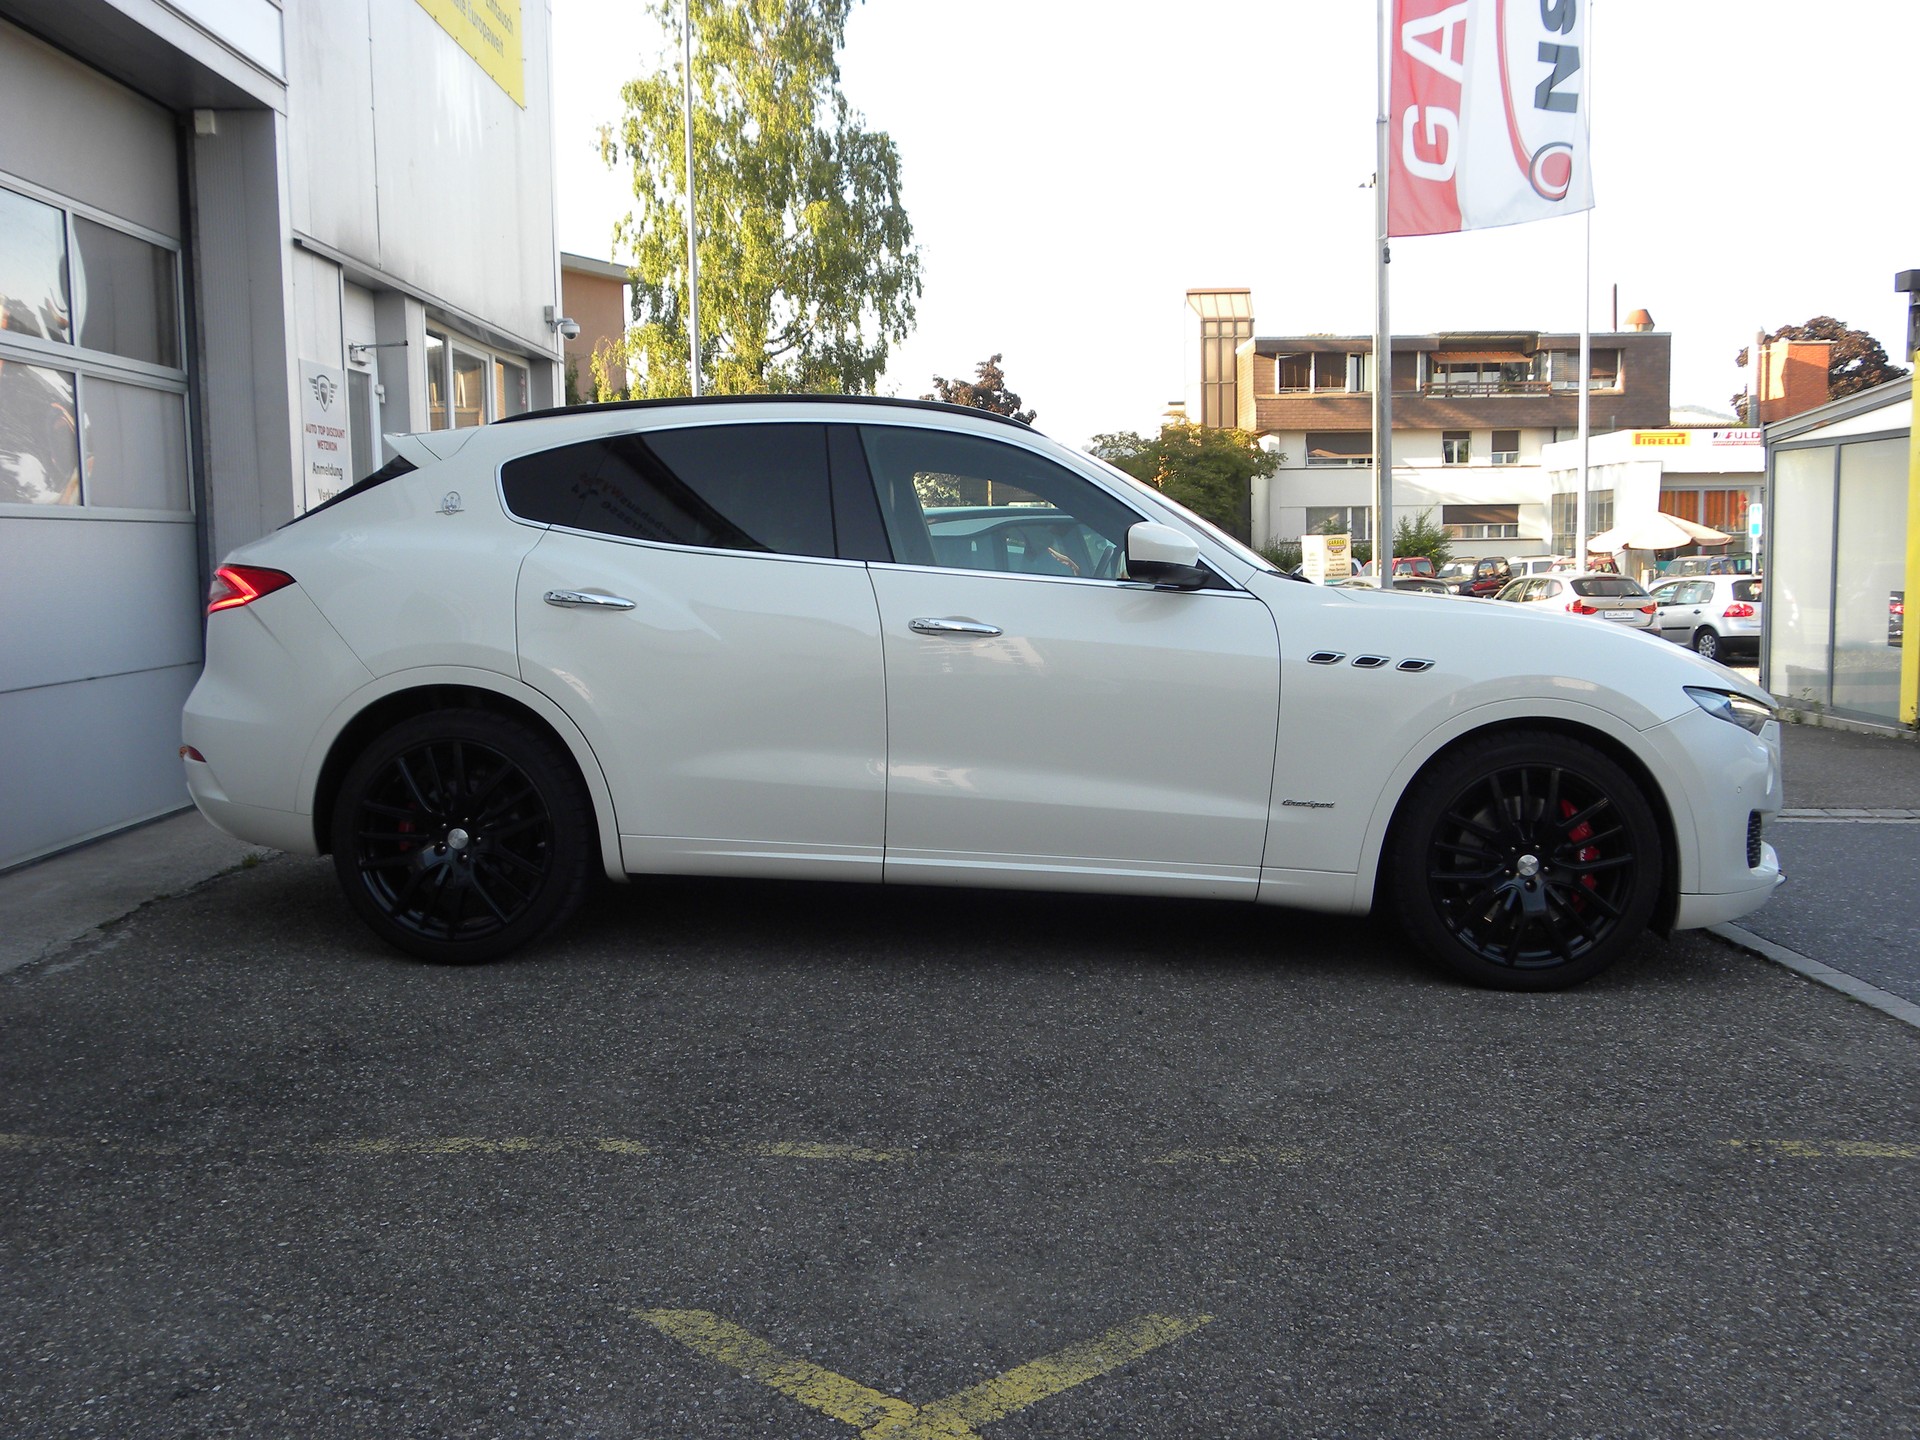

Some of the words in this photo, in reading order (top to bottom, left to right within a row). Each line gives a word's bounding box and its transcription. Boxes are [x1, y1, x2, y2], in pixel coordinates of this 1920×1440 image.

[305, 423, 317, 435] AUTO
[318, 425, 326, 436] TOP
[326, 426, 345, 439] DISCOUNT
[1635, 432, 1687, 445] PIRELLI
[317, 439, 338, 452] WETZIKON
[312, 461, 343, 480] Anmeldung
[1281, 799, 1335, 809] GranSport
